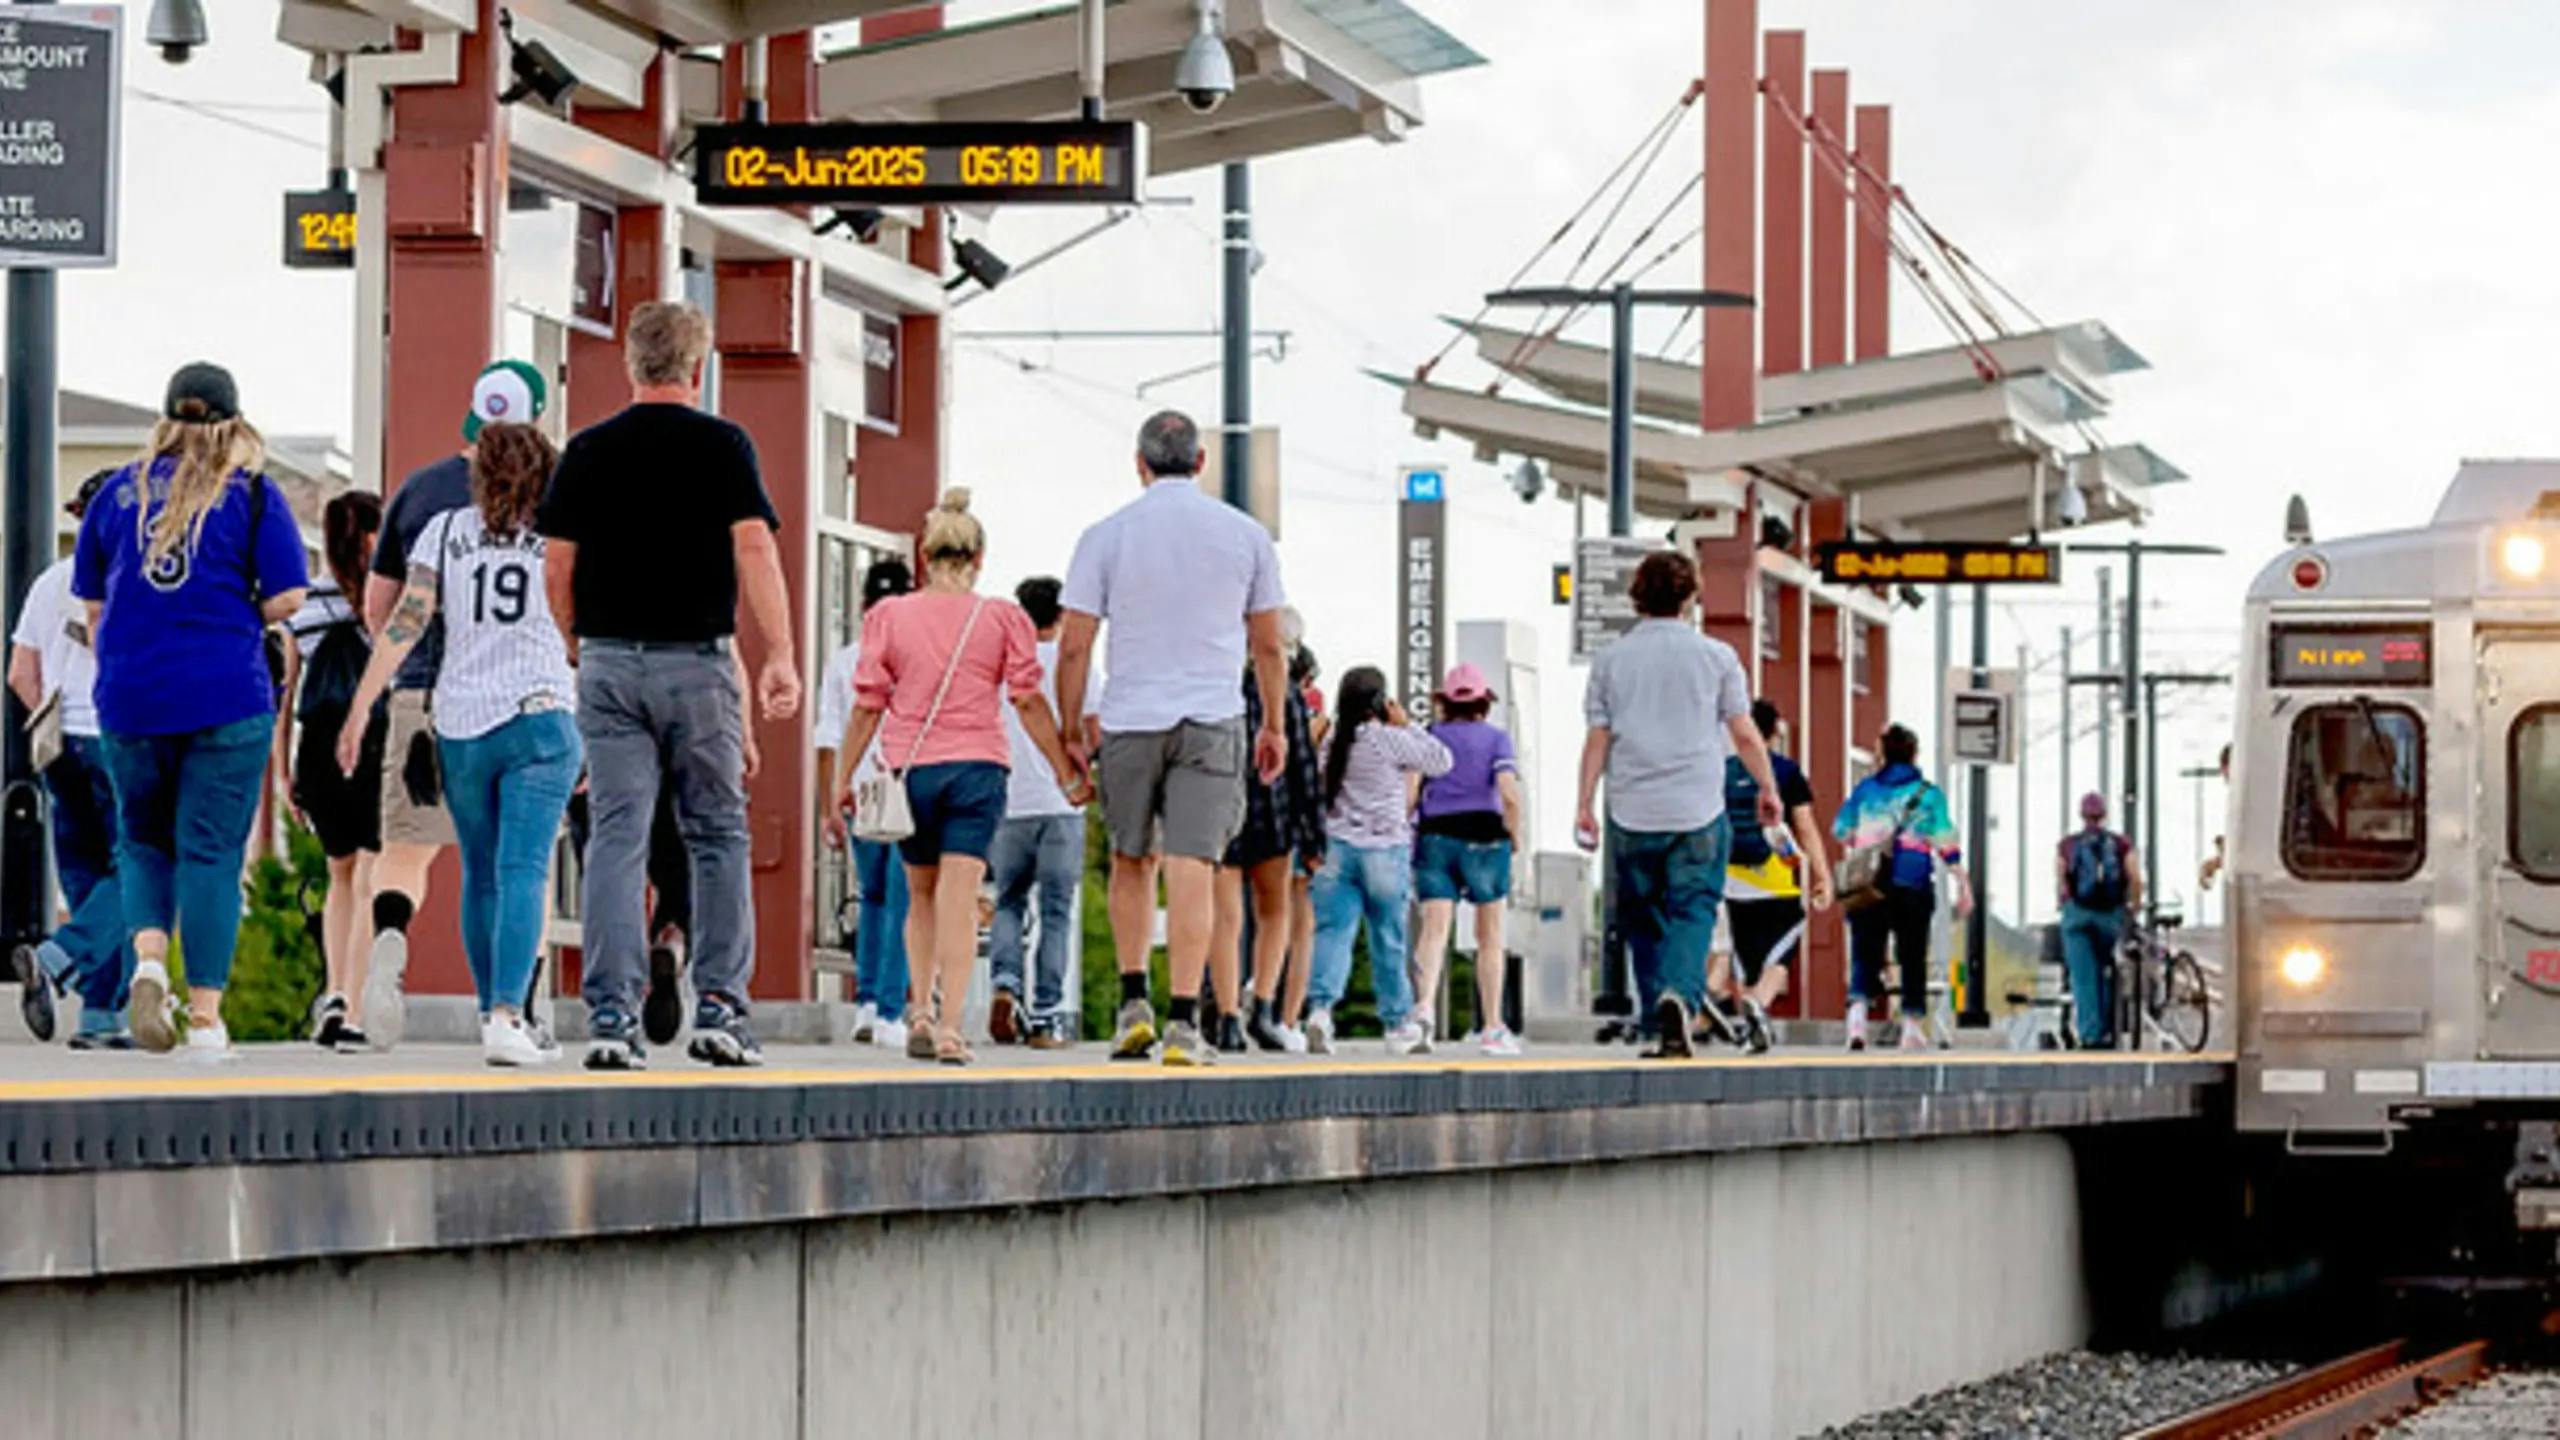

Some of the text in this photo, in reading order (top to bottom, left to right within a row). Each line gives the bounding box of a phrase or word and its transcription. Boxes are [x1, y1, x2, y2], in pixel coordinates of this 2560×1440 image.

[0, 46, 88, 68] MOUNT
[725, 144, 1104, 186] 02-Jun-2025 05:19 PM
[472, 562, 529, 623] 19
